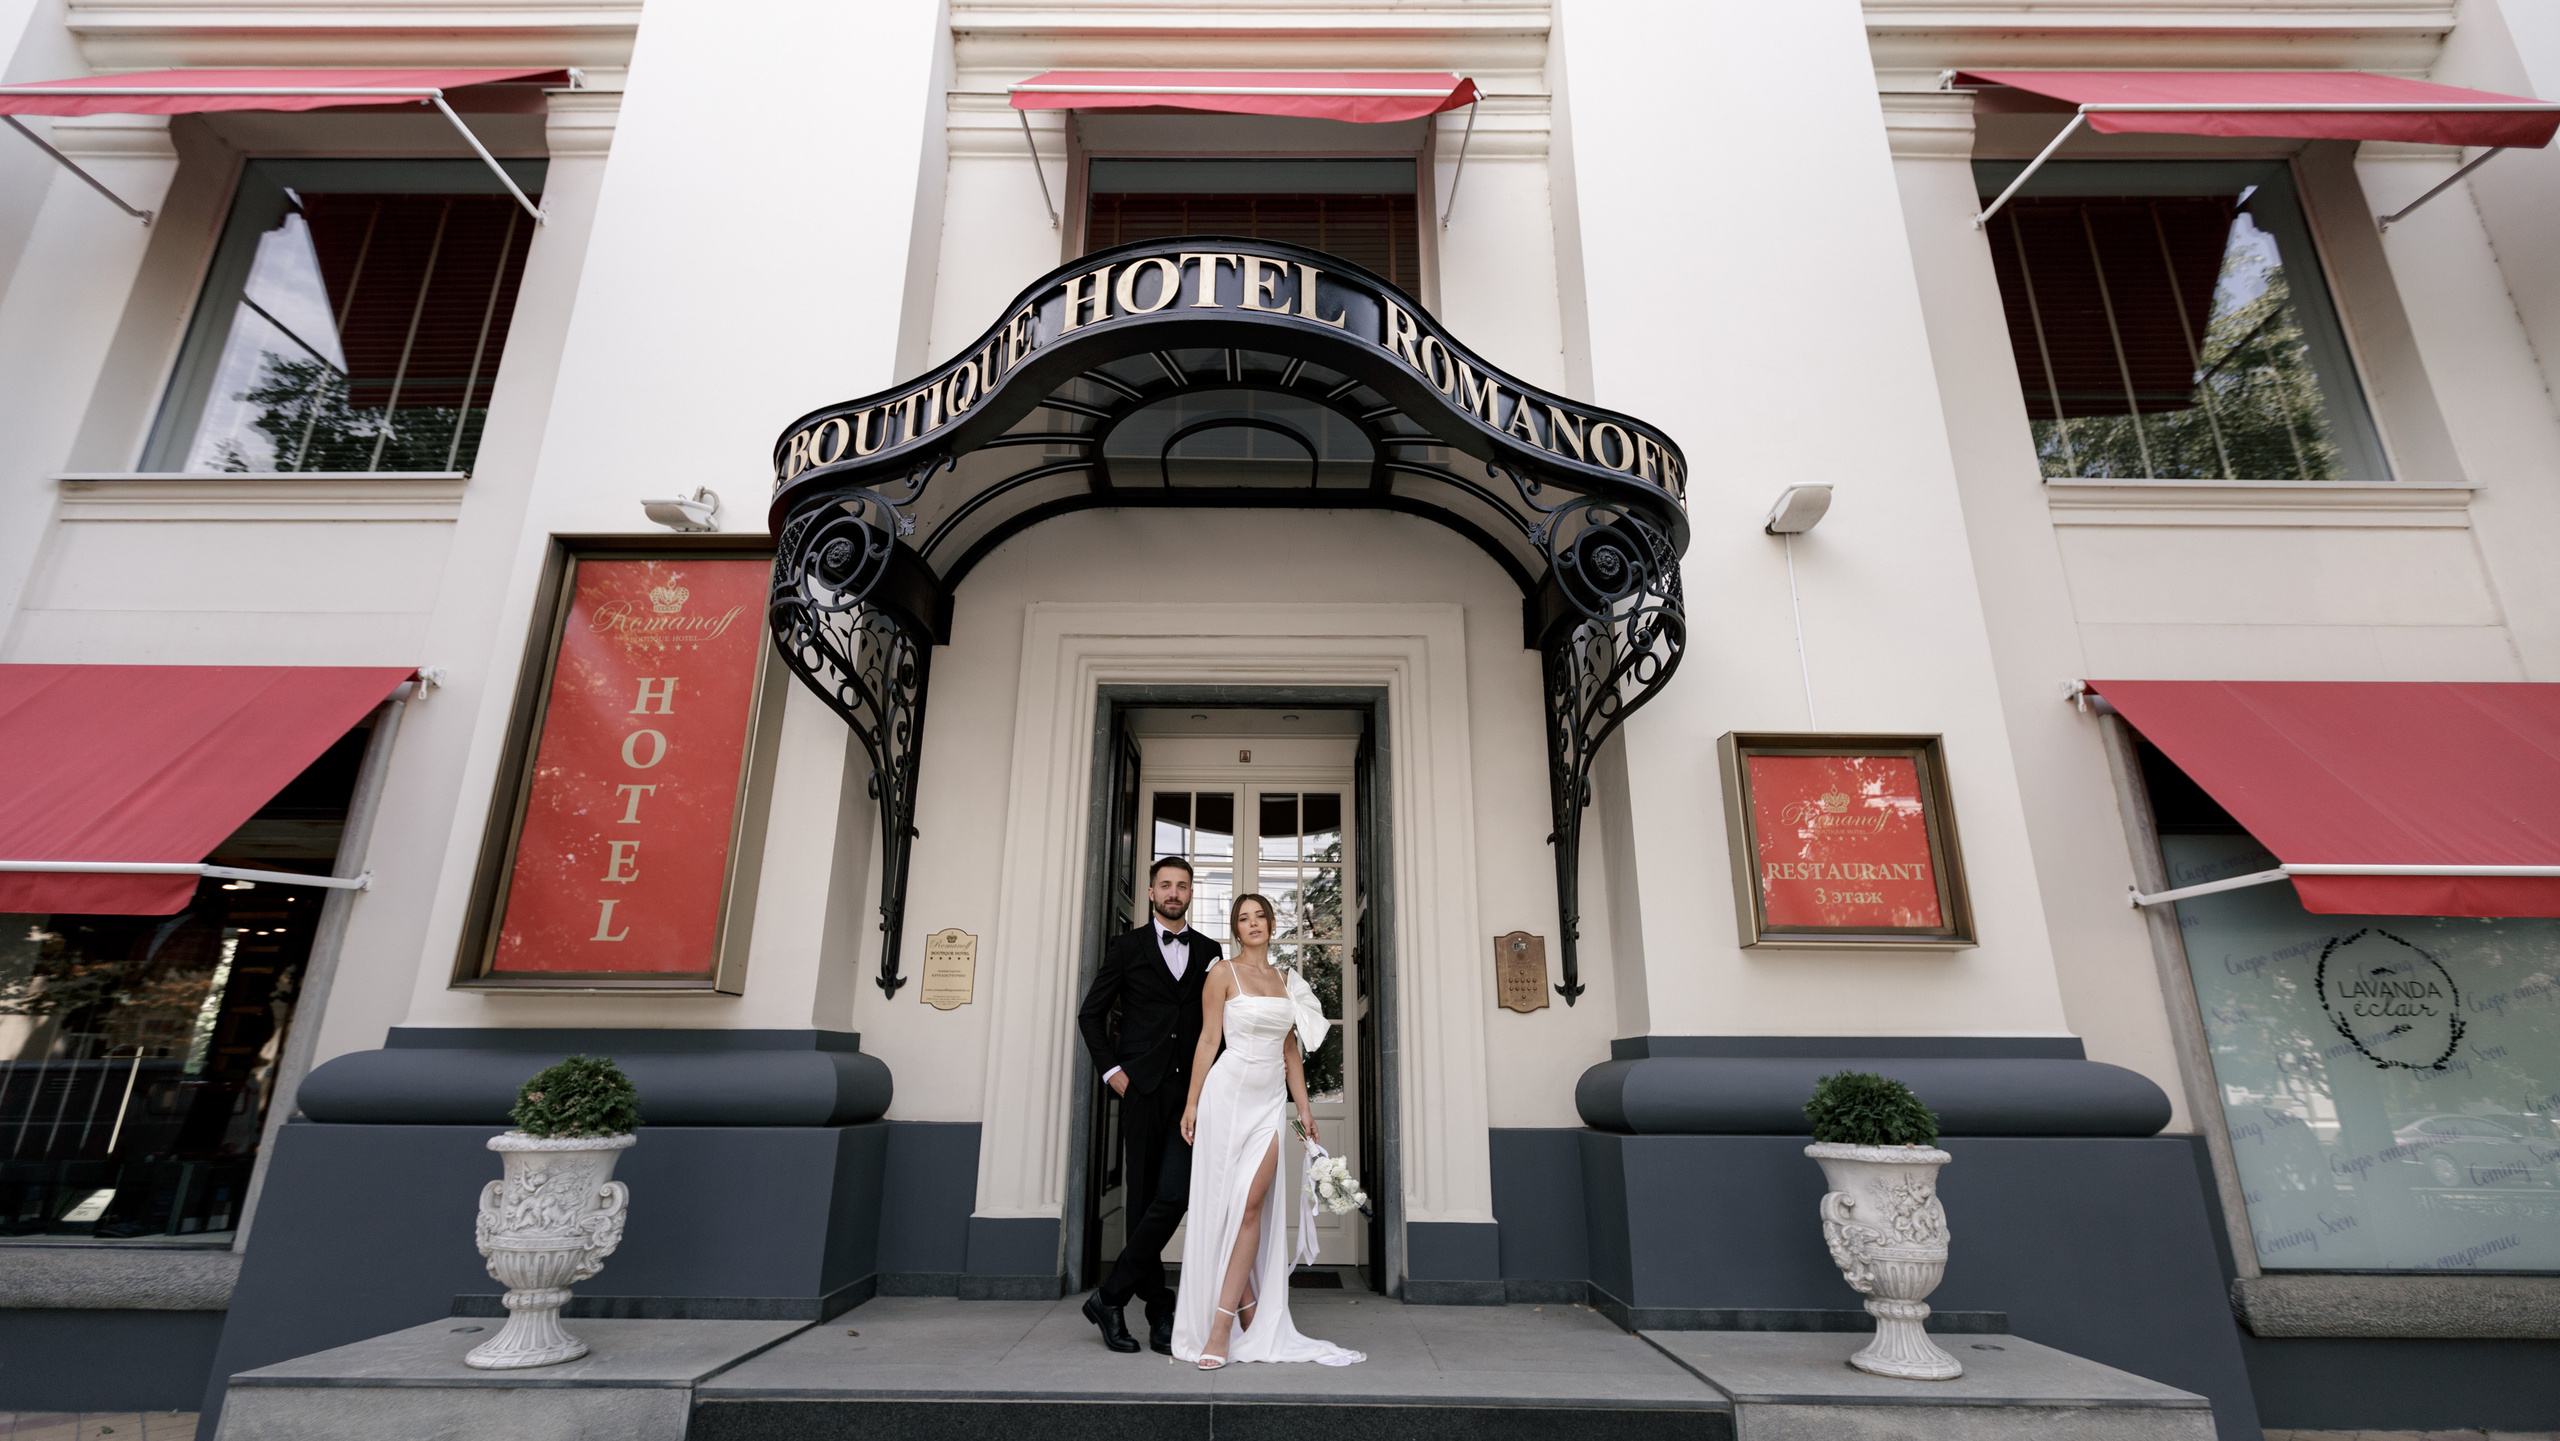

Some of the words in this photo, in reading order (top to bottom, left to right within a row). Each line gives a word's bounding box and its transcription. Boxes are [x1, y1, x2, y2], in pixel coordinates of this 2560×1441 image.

[784, 303, 1033, 484] BOUTIQUE
[1058, 252, 1346, 335] HOTEL
[1382, 295, 1681, 501] ROMANOFF
[588, 599, 747, 641] Romanoff
[629, 634, 668, 643] BOUTIQUE
[589, 677, 680, 942] HOTEL
[1781, 801, 1894, 834] Romanoff
[1766, 863, 1926, 881] RESTAURANT
[1814, 888, 1826, 904] 3
[1832, 891, 1883, 904] этаж
[2338, 981, 2443, 999] LAVANDA
[2353, 1001, 2440, 1017] éclair
